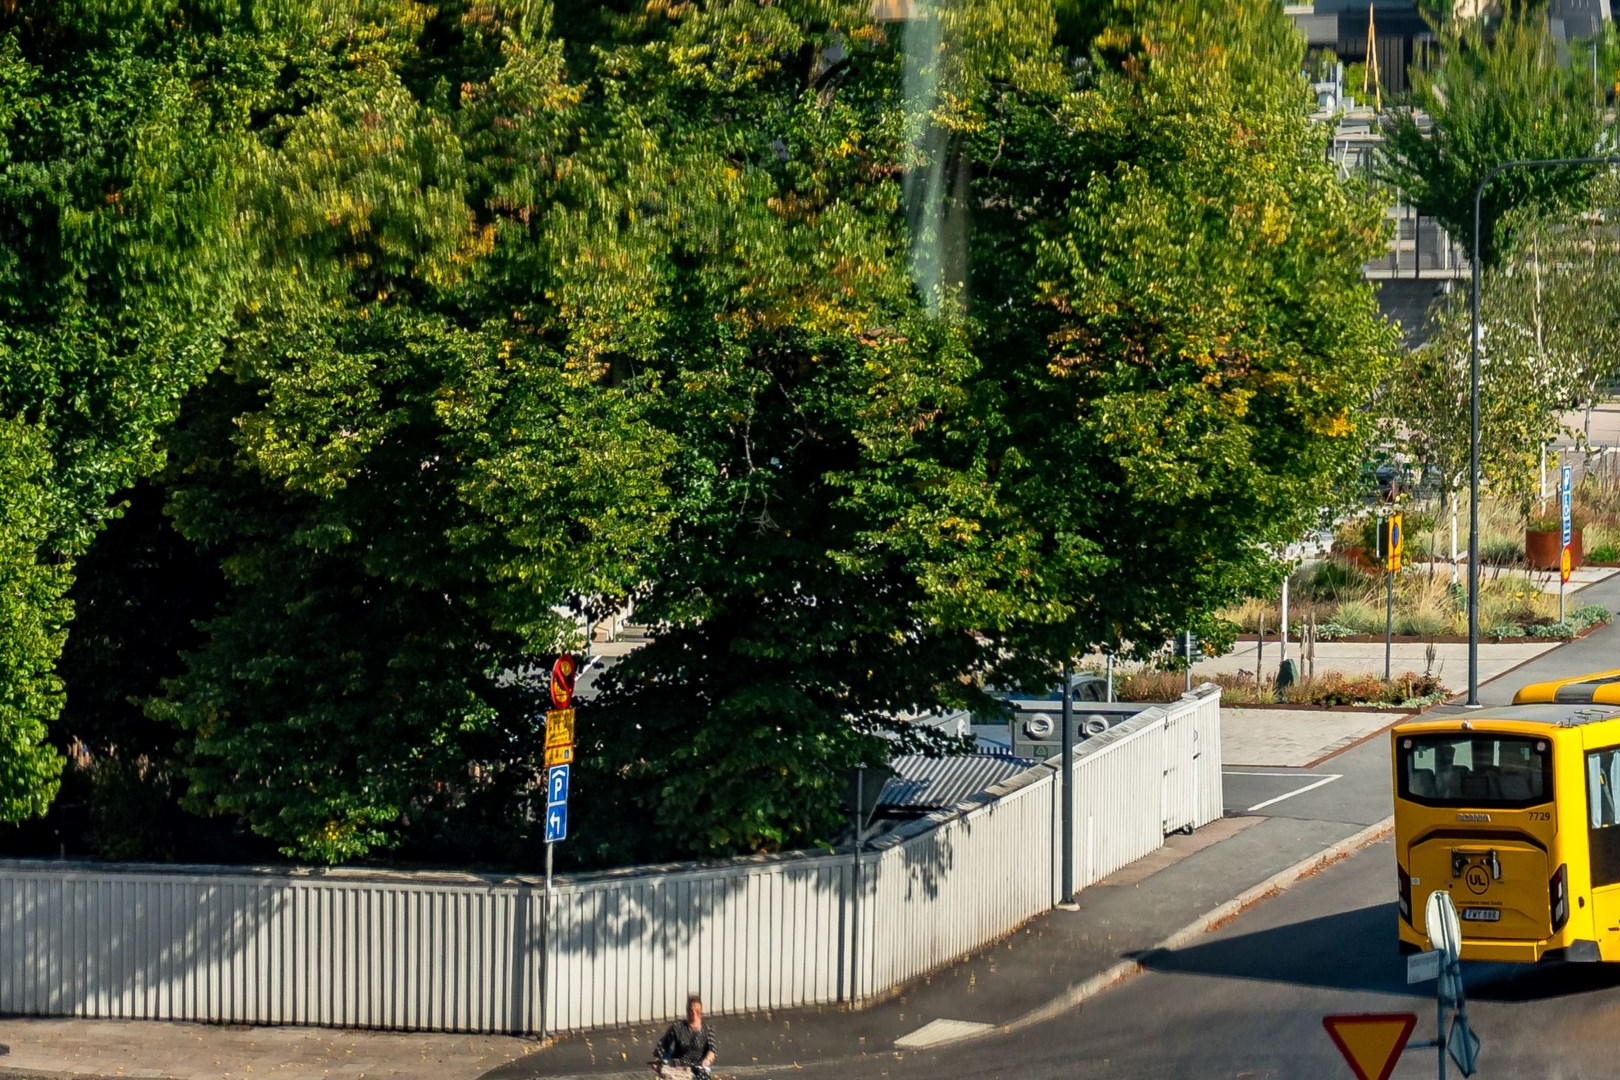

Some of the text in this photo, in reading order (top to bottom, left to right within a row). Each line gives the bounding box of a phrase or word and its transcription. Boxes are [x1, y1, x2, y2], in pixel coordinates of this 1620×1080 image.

[554, 777, 563, 801] P
[1528, 811, 1551, 822] 7729
[1469, 874, 1486, 886] UL
